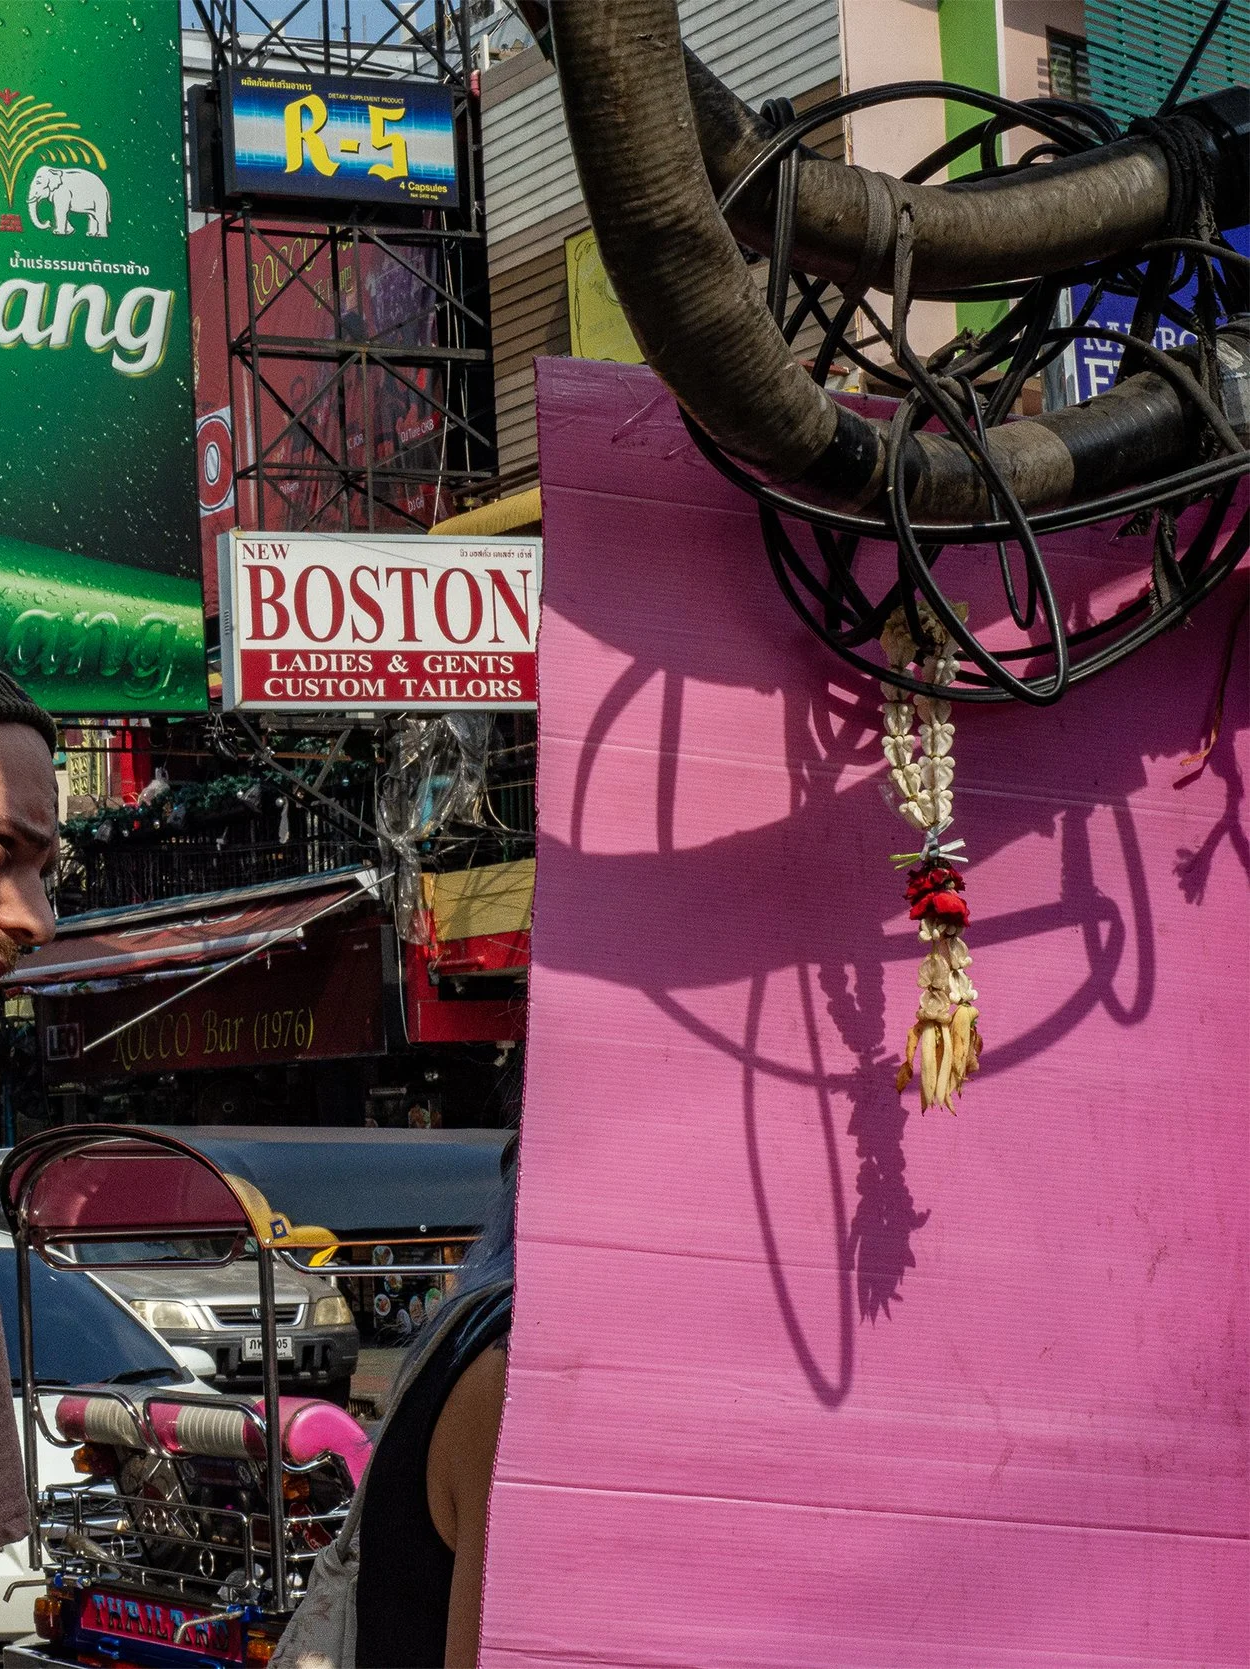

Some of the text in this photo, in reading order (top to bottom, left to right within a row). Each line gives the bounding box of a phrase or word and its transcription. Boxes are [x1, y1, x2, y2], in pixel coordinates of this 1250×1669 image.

[284, 94, 408, 181] R-5
[400, 181, 448, 193] 4 Capsules
[242, 543, 290, 560] NEW
[242, 564, 533, 645] BOSTON
[269, 653, 515, 675] LADIES & GENTS
[263, 677, 523, 699] CUSTOM TAILORS
[203, 1008, 244, 1055] Bar
[253, 1006, 315, 1054] (1976)
[92, 1594, 228, 1651] THAILAND
